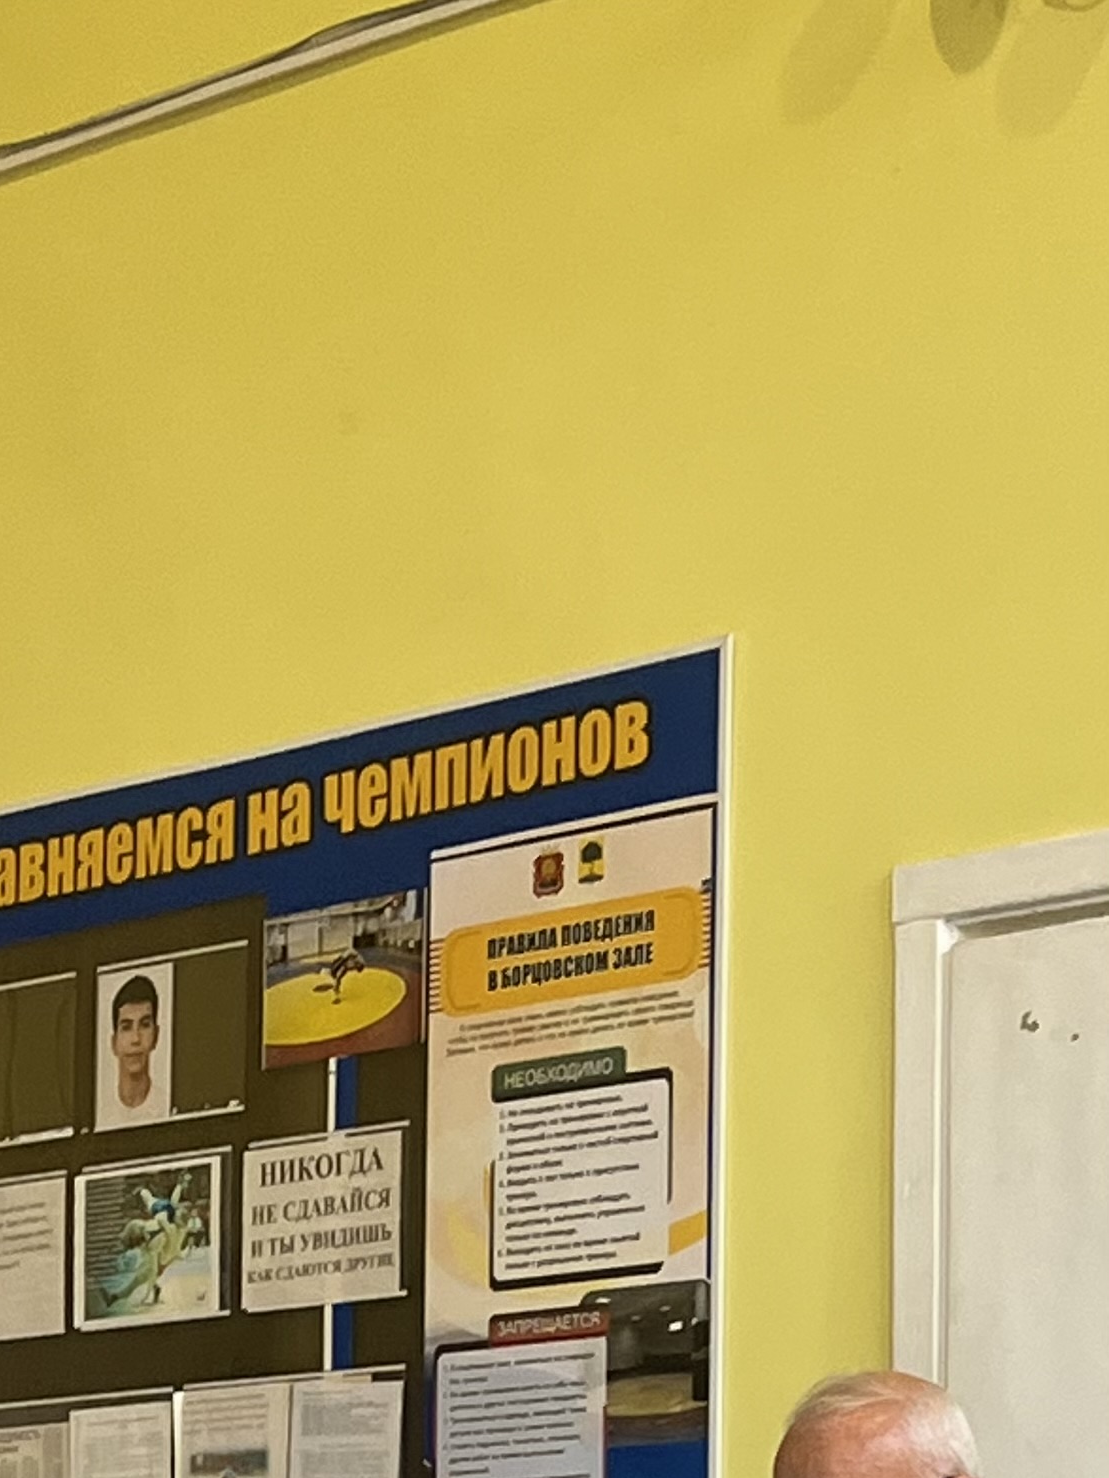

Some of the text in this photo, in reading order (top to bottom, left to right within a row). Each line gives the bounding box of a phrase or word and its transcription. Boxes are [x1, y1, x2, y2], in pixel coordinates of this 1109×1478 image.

[245, 780, 312, 857] на
[323, 700, 653, 836] чемпионов
[487, 909, 655, 960] ПРАВИЛА ПОВЕДЕНИЯ
[487, 942, 654, 992] В БОРЦОВСКОМ ЗАЛЕ
[503, 1057, 614, 1090] НЕОБХОДИМО
[259, 1147, 384, 1188] НИКОГДА
[251, 1187, 391, 1226] НЕ СДАВАЙСЯ
[251, 1222, 393, 1258] И ТЫ УВИДИШЬ
[247, 1252, 395, 1284] КАК СДАЮТСЯ ДРУГИЕ
[497, 1312, 601, 1338] ЗАПРЕЩАЕТСЯ
